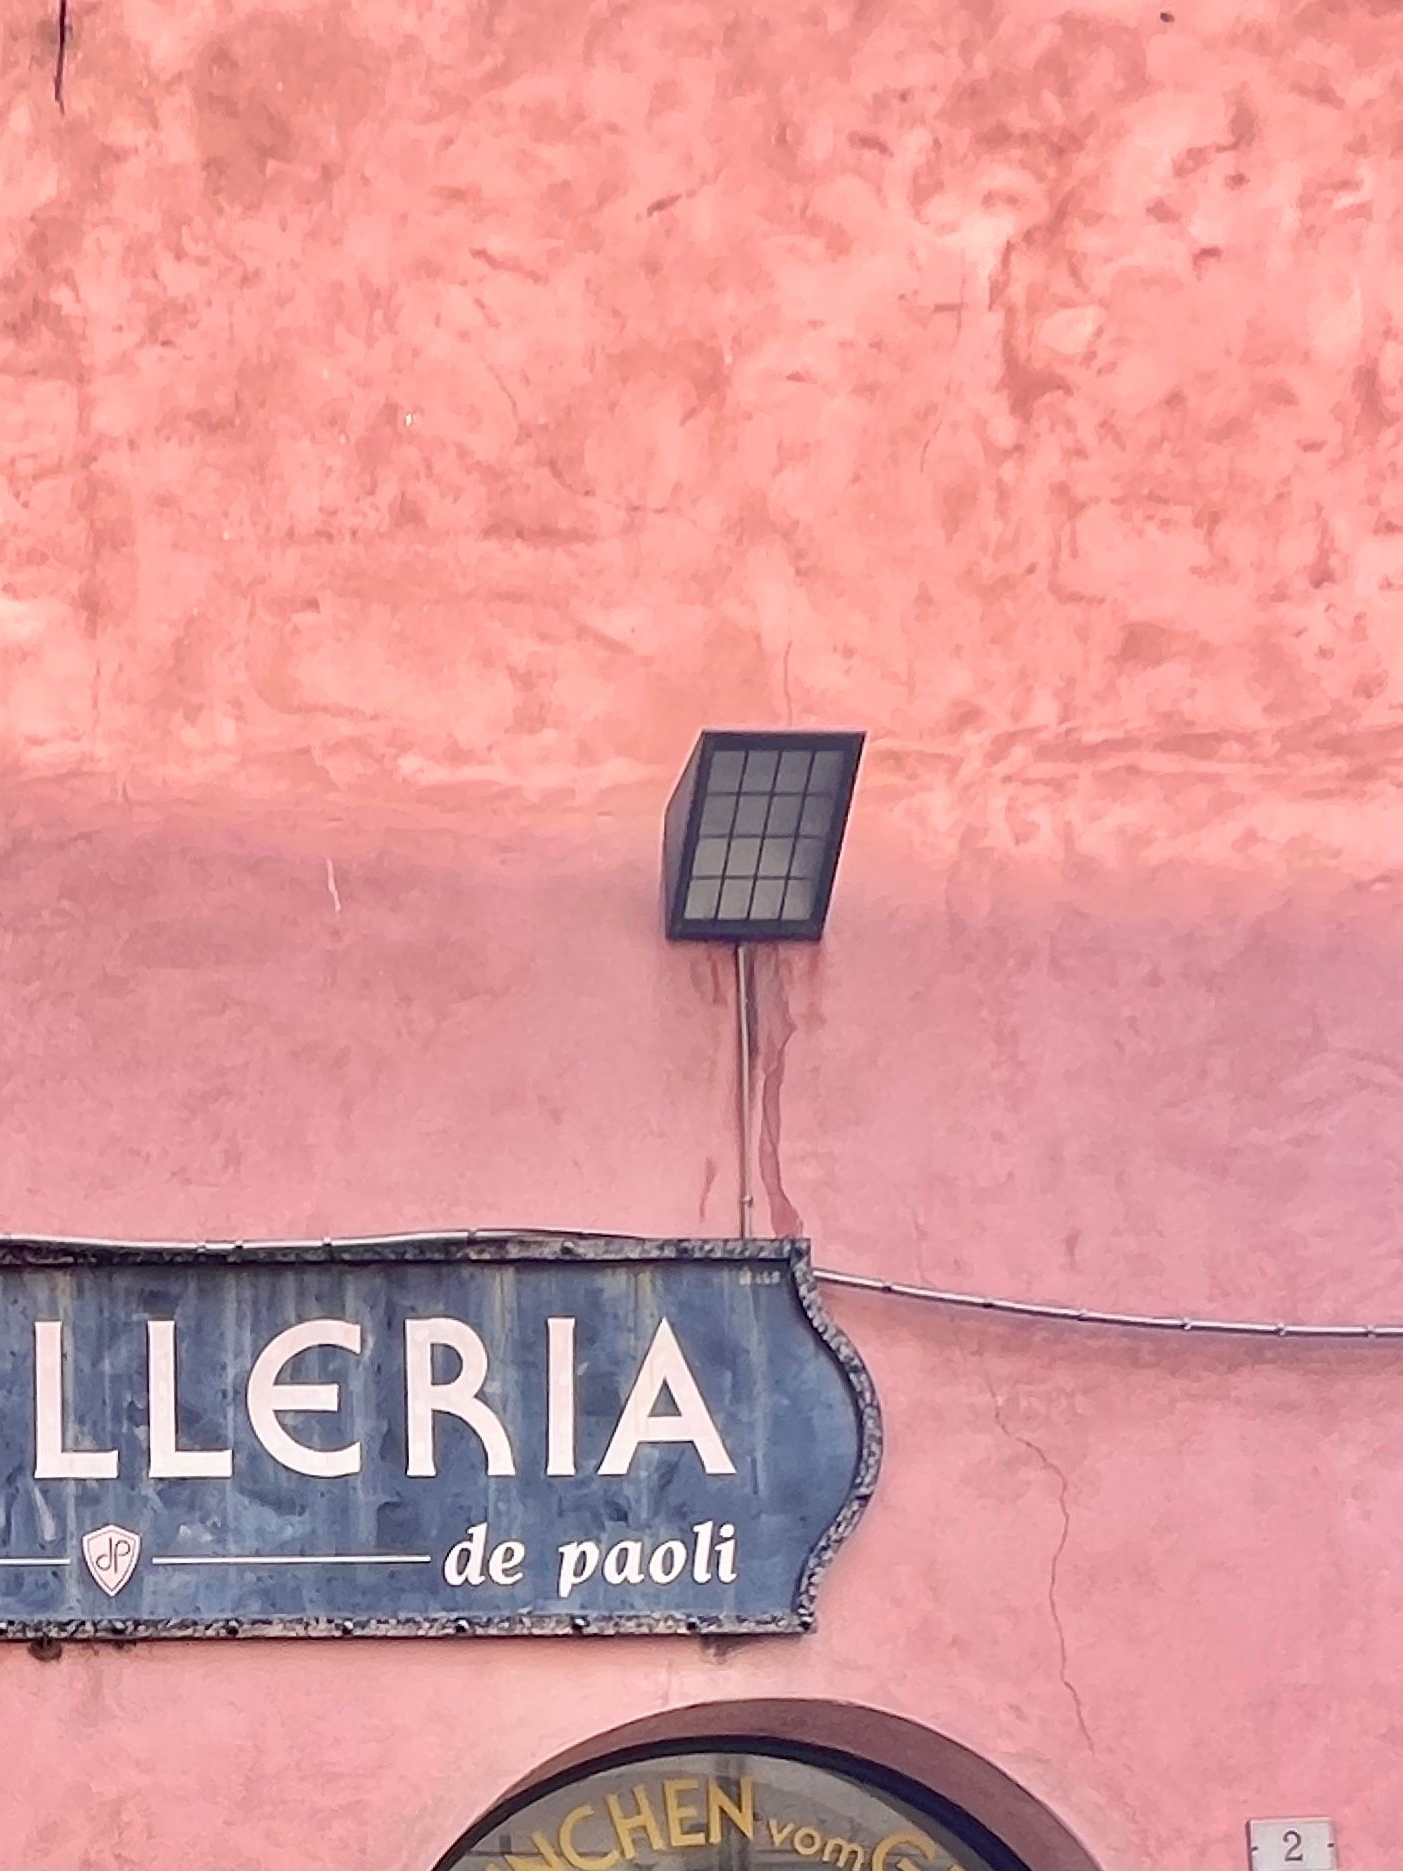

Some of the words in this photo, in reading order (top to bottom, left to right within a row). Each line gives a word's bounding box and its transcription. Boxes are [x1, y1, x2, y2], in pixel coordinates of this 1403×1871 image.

[444, 1522, 526, 1586] de
[558, 1520, 739, 1598] paoli
[1282, 1830, 1304, 1862] 2
